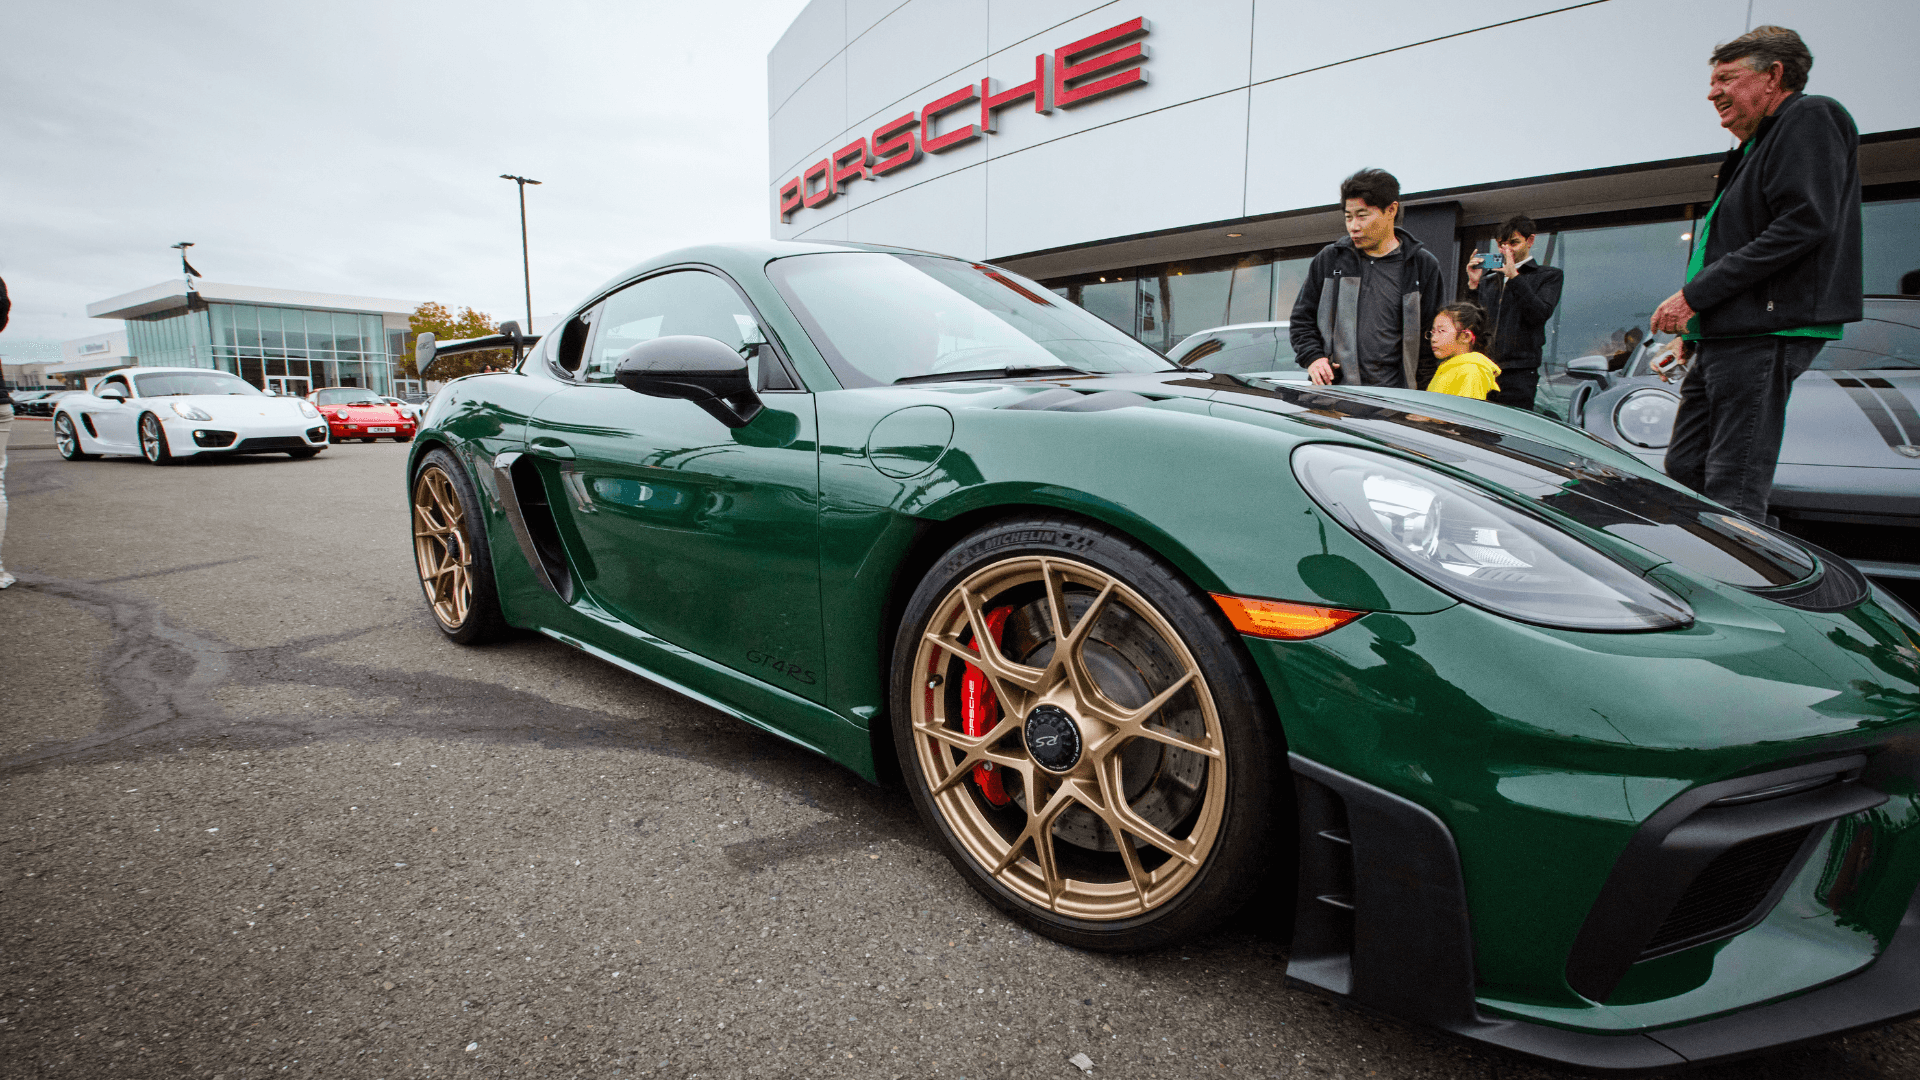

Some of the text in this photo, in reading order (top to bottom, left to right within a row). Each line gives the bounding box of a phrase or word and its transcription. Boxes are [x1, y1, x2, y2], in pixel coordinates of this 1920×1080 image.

[780, 16, 1149, 224] PORSCHE
[984, 531, 1054, 549] MICHELIN
[1035, 735, 1058, 748] RS
